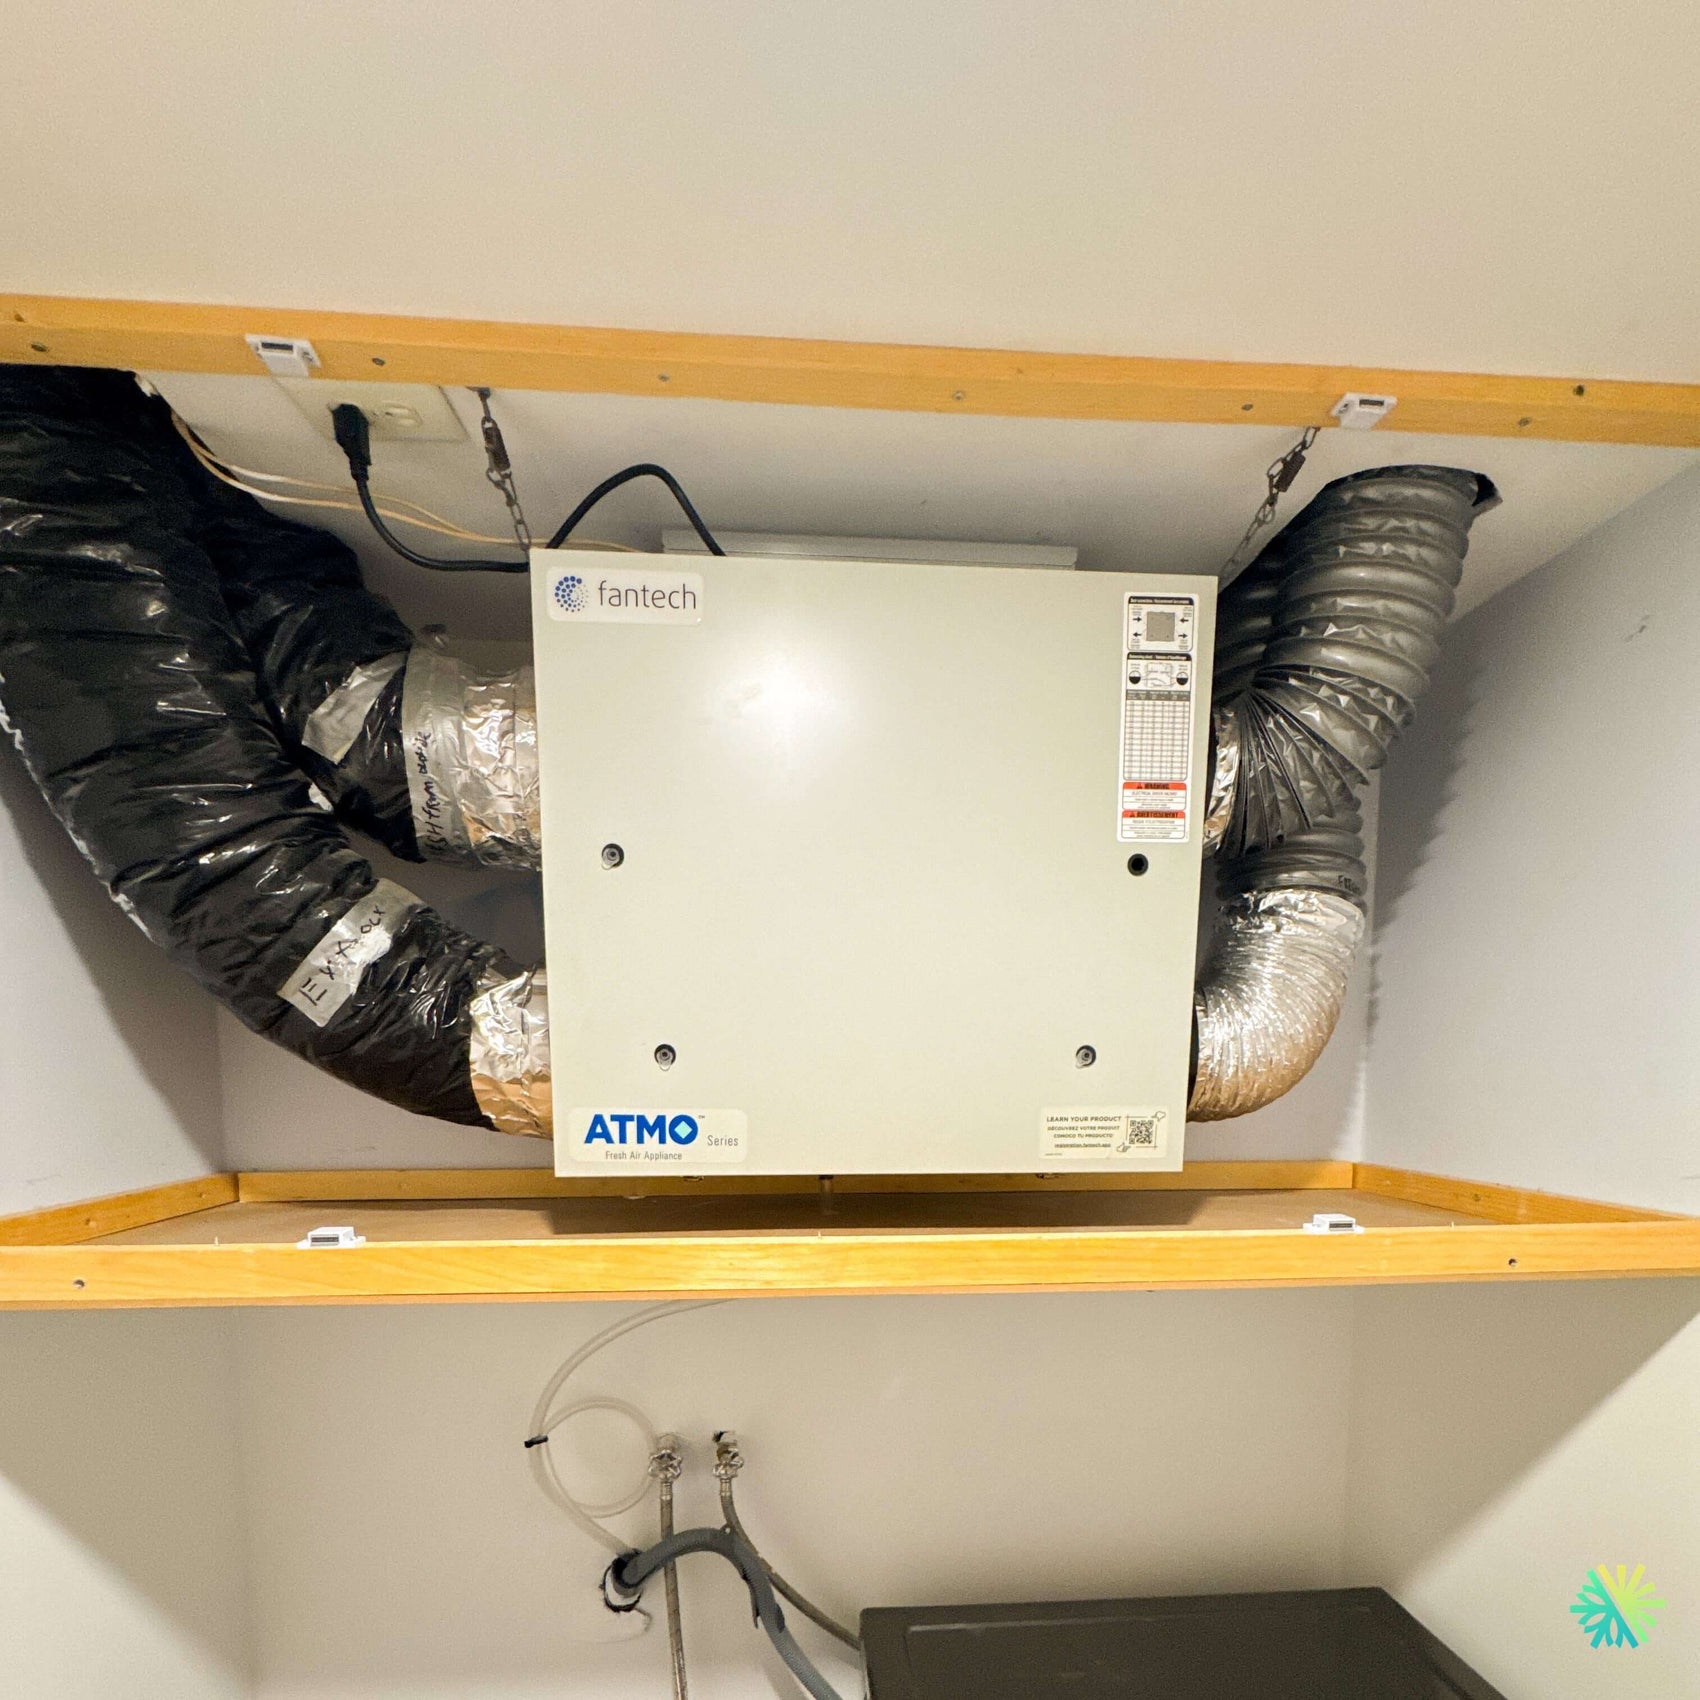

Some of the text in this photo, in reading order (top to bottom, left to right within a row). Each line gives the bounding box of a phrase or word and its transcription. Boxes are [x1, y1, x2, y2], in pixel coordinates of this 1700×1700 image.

[598, 580, 697, 609] fantech
[584, 1113, 699, 1145] ATMO
[707, 1134, 739, 1147] Series
[605, 1151, 682, 1161] Fresh Air Appliance
